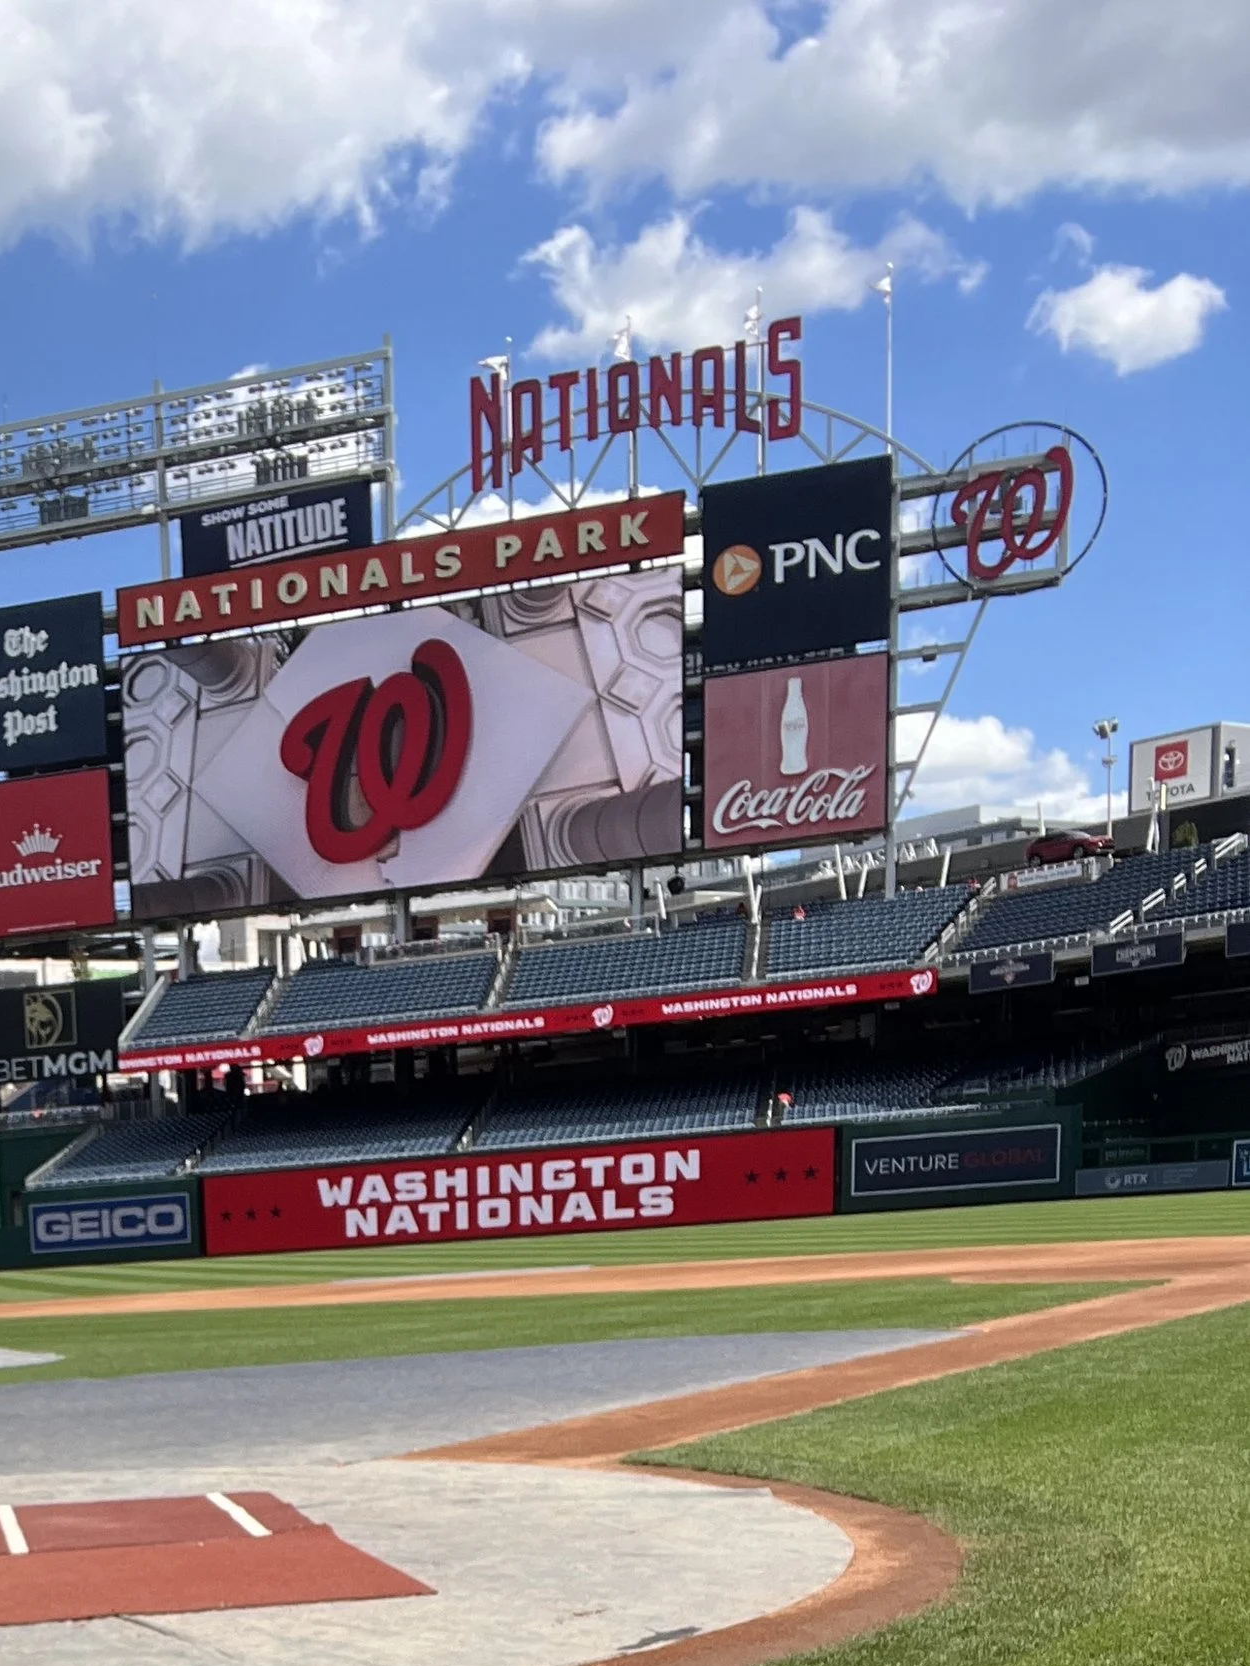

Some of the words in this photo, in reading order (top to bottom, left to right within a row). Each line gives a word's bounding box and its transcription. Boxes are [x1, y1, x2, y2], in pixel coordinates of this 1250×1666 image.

[470, 316, 802, 493] NATIONALS
[201, 505, 246, 527] SHOW
[247, 495, 289, 515] SOME
[226, 497, 349, 561] NATITUDE
[136, 545, 462, 630] NATIONALS
[495, 511, 650, 568] PARK
[768, 528, 881, 584] PNC
[3, 625, 50, 659] The
[3, 704, 59, 747] Post
[712, 763, 877, 834] Coca-Cola
[661, 993, 761, 1016] WASHINGTON
[765, 983, 857, 1005] NATIONALS
[367, 1025, 459, 1045] WASHINGTON
[462, 1016, 545, 1036] NATIONALS
[185, 1046, 262, 1064] NATIONALS
[317, 1149, 701, 1207] WASHINGTON
[865, 1152, 959, 1176] VENTURE
[963, 1148, 1047, 1168] GLOBAL
[1123, 1173, 1148, 1186] RTX
[35, 1203, 185, 1243] GEICO
[345, 1186, 674, 1238] NATIONALS
